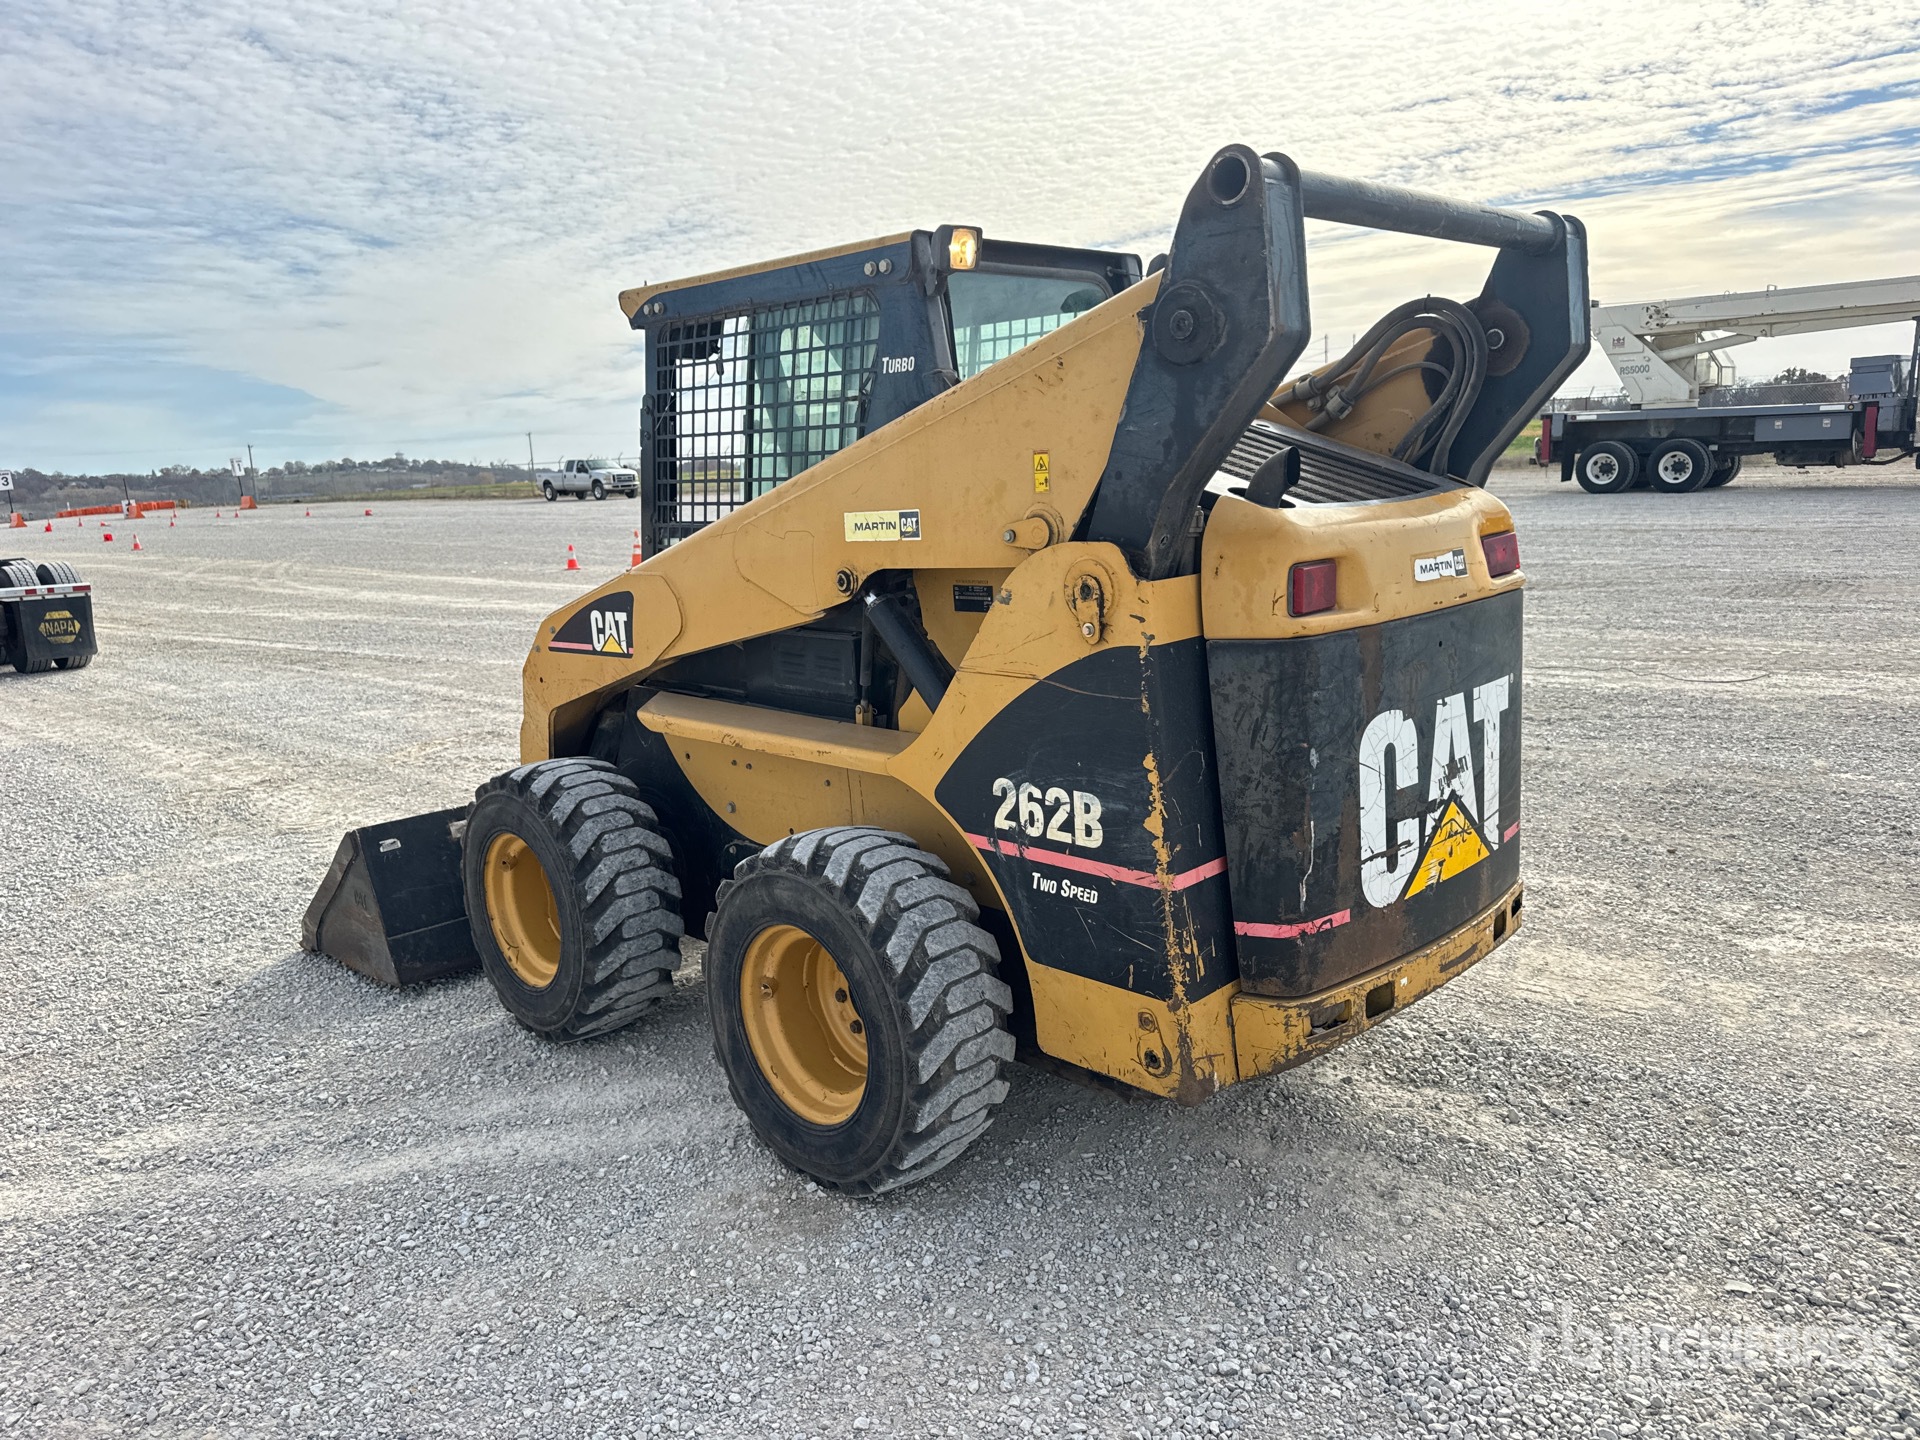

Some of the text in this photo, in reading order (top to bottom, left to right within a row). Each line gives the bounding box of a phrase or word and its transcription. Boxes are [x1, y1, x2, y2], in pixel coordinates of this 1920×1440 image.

[882, 356, 915, 374] TURBO
[1619, 364, 1650, 375] RS5000
[1, 476, 9, 486] 3
[854, 518, 918, 532] MARTIN CAT
[1420, 560, 1453, 574] MARTIN
[45, 620, 75, 636] NAPA
[590, 610, 628, 654] CAT
[1359, 675, 1510, 909] CAT
[992, 777, 1104, 849] 262B
[1031, 872, 1099, 904] TWO SPEED
